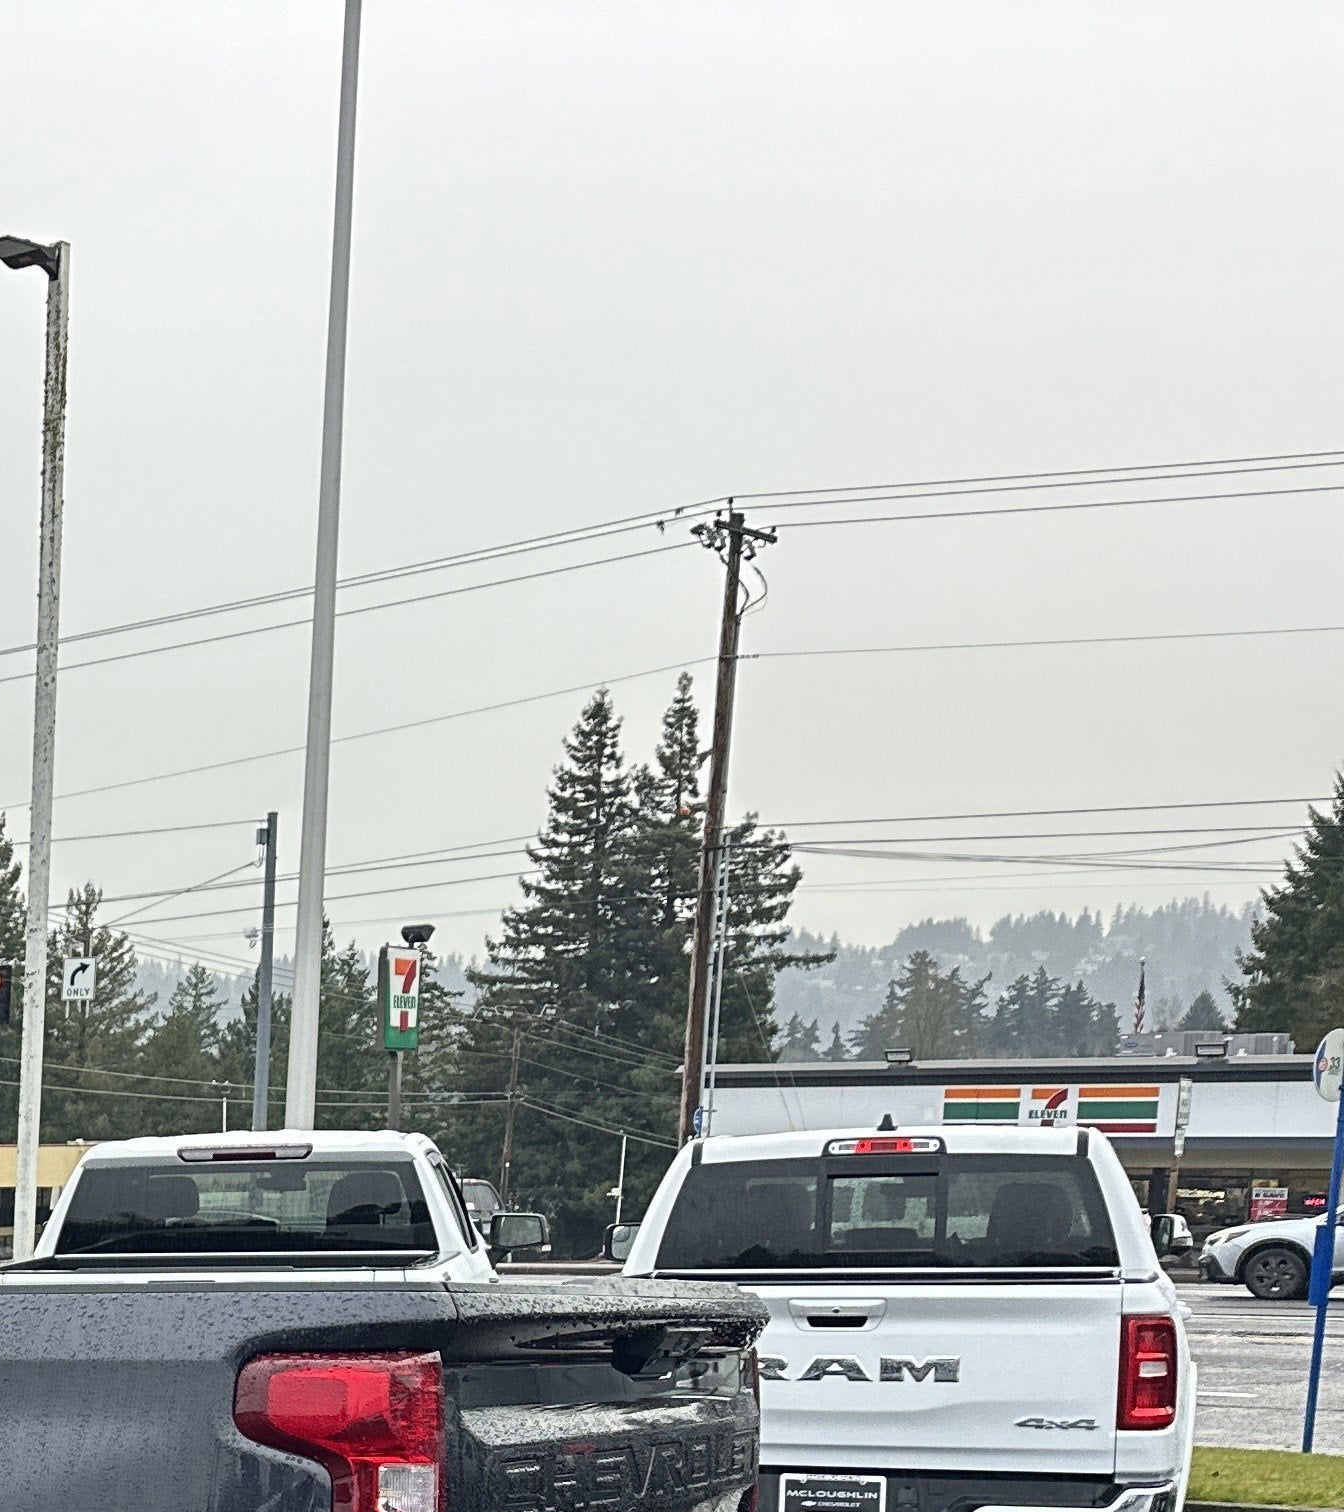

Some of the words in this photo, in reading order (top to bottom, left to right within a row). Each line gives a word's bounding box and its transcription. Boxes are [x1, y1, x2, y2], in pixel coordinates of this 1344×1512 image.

[67, 988, 91, 997] ONLY
[758, 1356, 960, 1382] RAM
[1013, 1418, 1100, 1431] 4x4
[786, 1489, 878, 1499] MCLOUGHLIN
